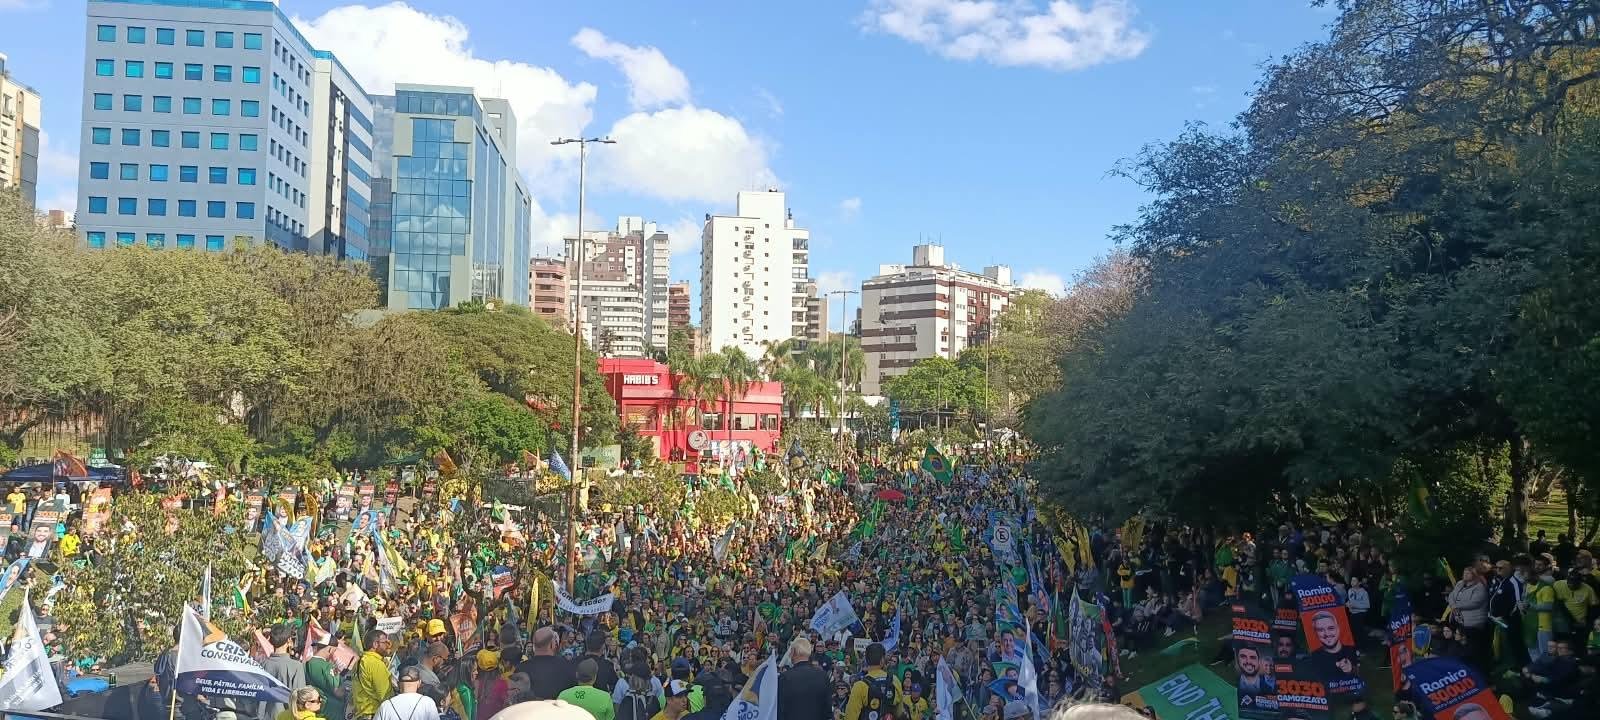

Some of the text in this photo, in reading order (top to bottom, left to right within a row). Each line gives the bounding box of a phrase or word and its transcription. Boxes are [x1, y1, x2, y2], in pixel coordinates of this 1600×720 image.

[623, 374, 659, 385] HABIB'S
[1298, 585, 1332, 599] Ramiro
[584, 597, 607, 607] todos
[1301, 594, 1336, 607] 30000
[1232, 617, 1270, 632] 3030
[1276, 680, 1326, 697] 3030
[1419, 669, 1468, 694] Ramiro
[221, 688, 257, 697] LIBERDADE
[1156, 673, 1206, 706] END
[1427, 677, 1477, 705] 30000
[1277, 694, 1328, 705] CAMOZZATO
